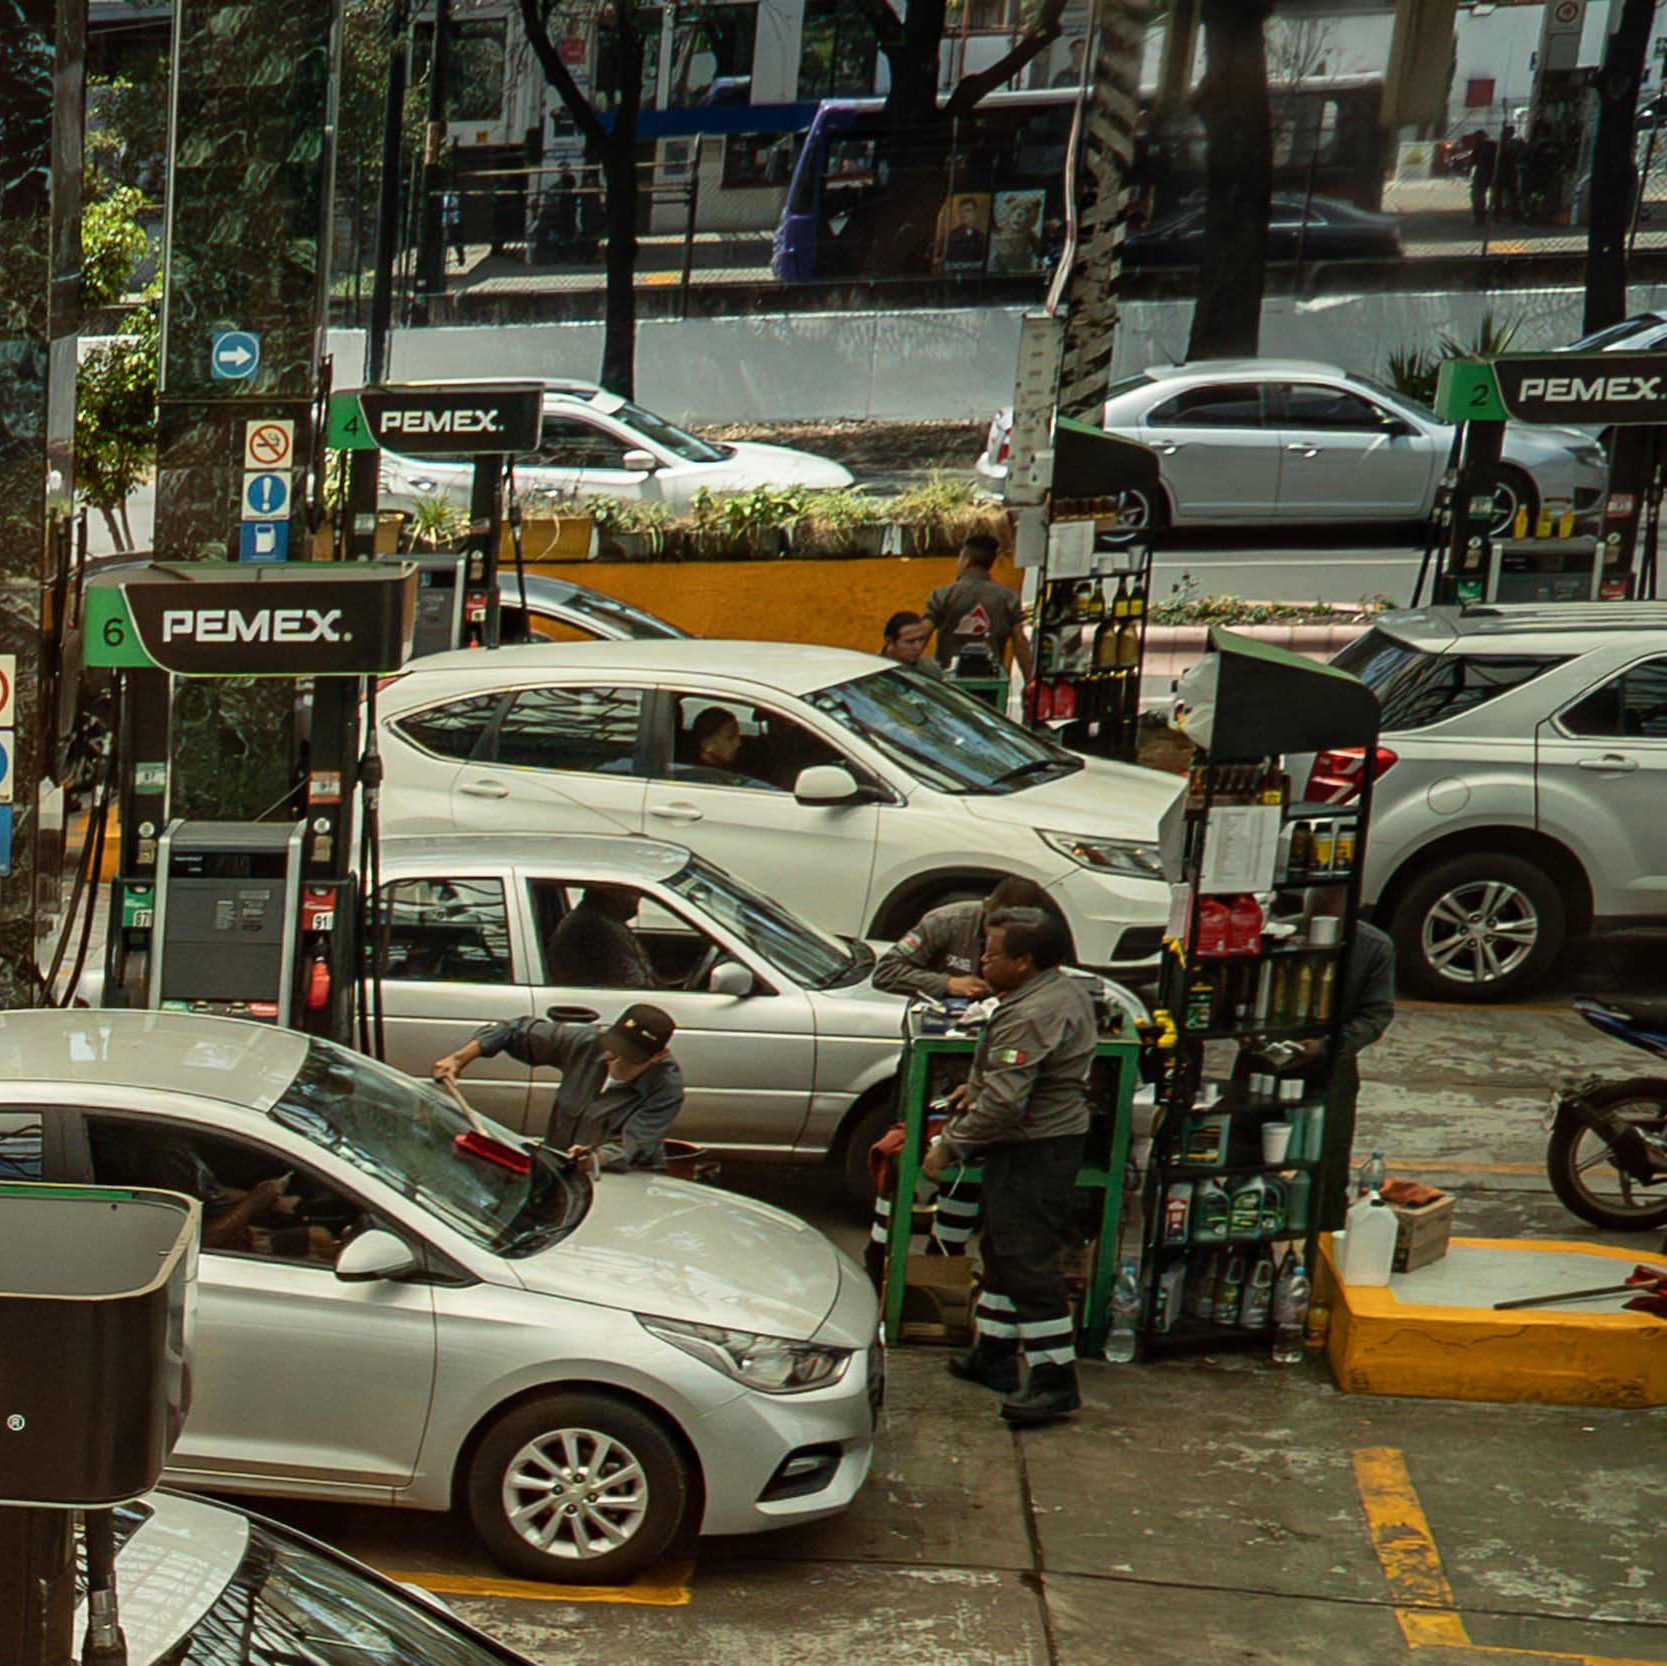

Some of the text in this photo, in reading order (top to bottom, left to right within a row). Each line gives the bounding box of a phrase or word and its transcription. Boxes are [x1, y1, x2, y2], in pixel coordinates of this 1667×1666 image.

[1470, 384, 1489, 406] 2
[1518, 377, 1661, 402] PEMEX
[343, 416, 359, 436] 4
[380, 410, 499, 433] PEMEX
[103, 617, 125, 647] 6
[162, 609, 342, 643] PEMEX
[316, 915, 328, 929] 91
